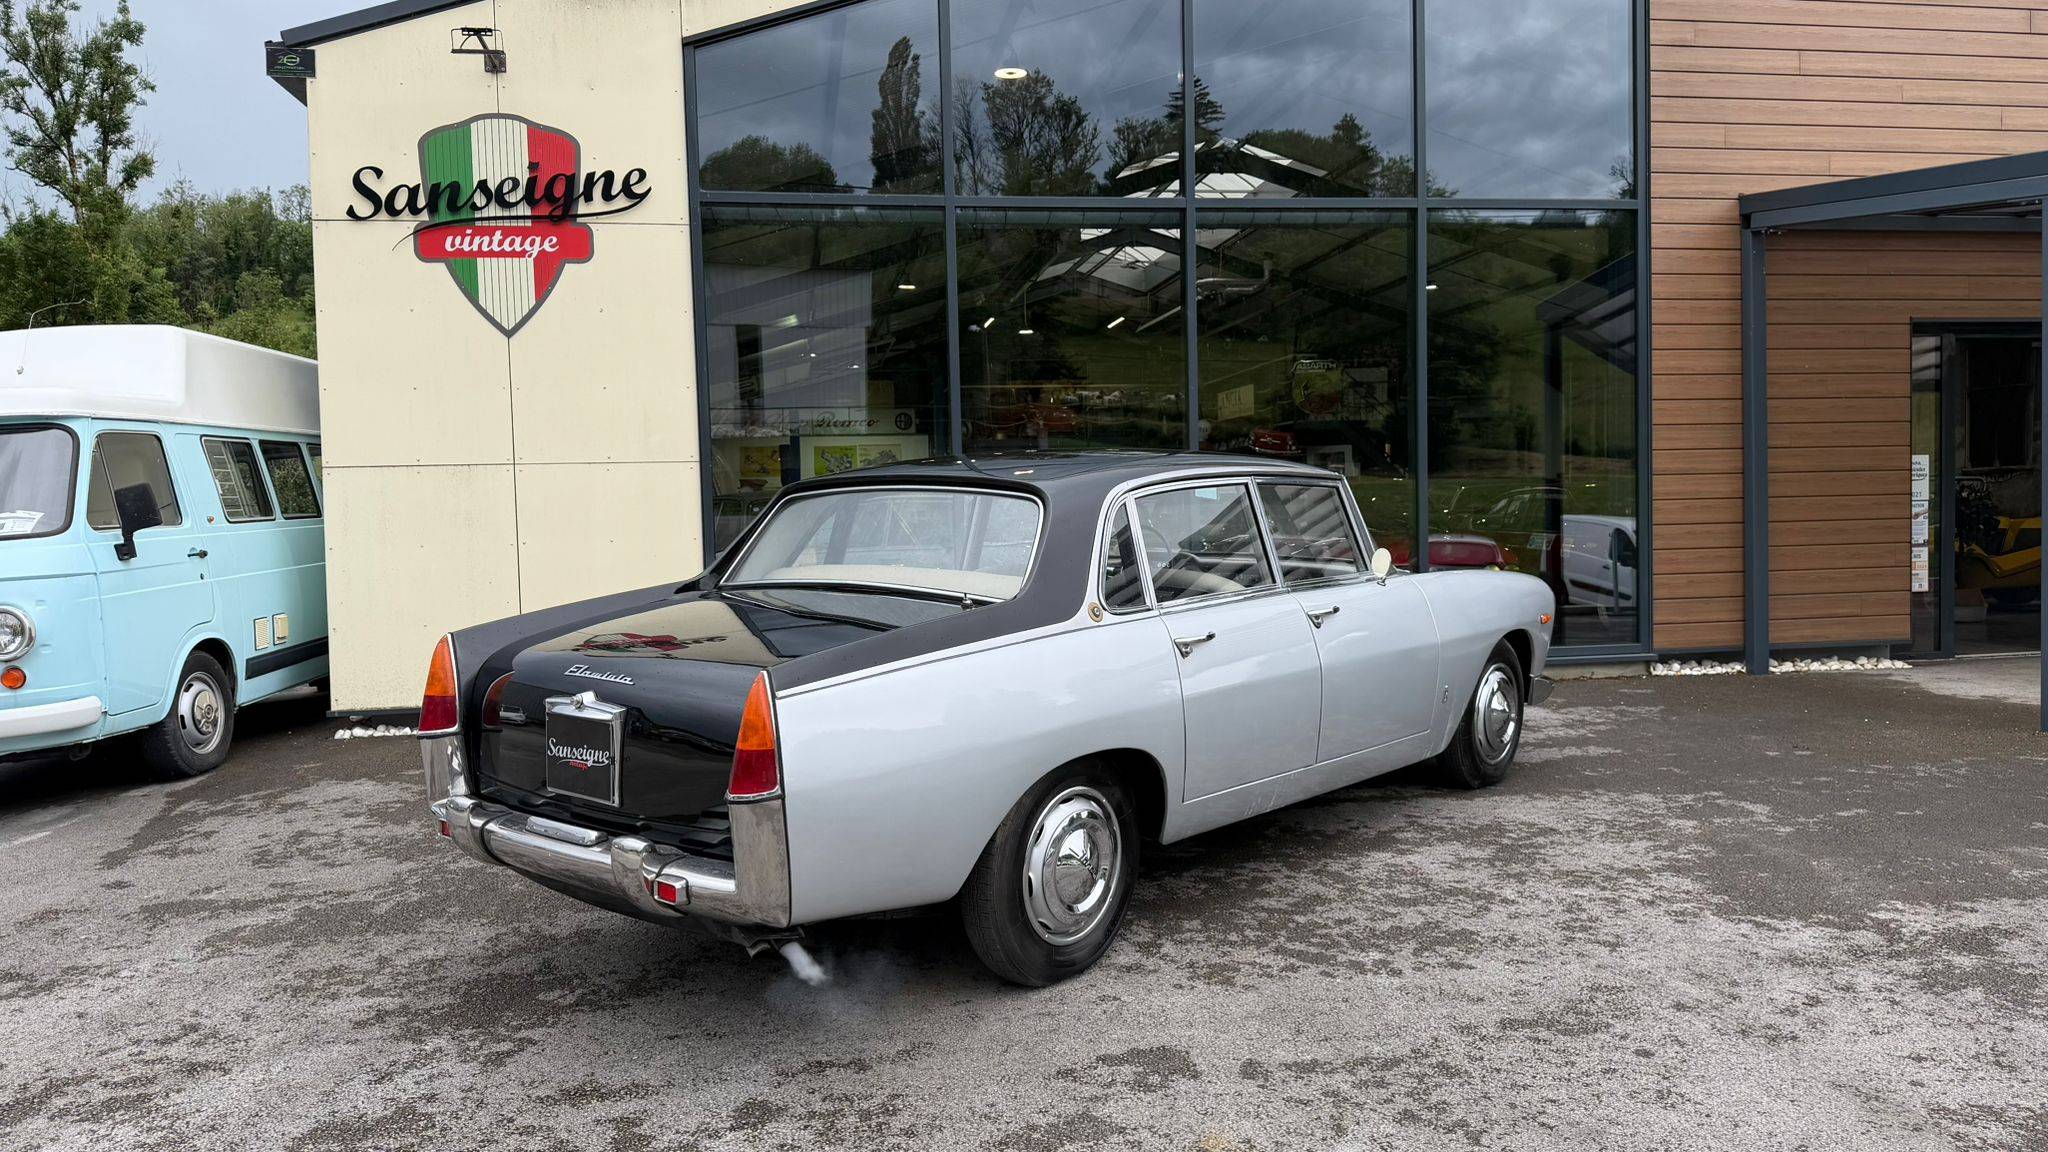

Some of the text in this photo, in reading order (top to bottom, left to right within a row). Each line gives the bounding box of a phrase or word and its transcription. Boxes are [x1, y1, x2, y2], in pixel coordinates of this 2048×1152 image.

[346, 162, 652, 222] Sanseigne
[444, 229, 560, 260] vintage
[547, 737, 611, 767] Sanseigne
